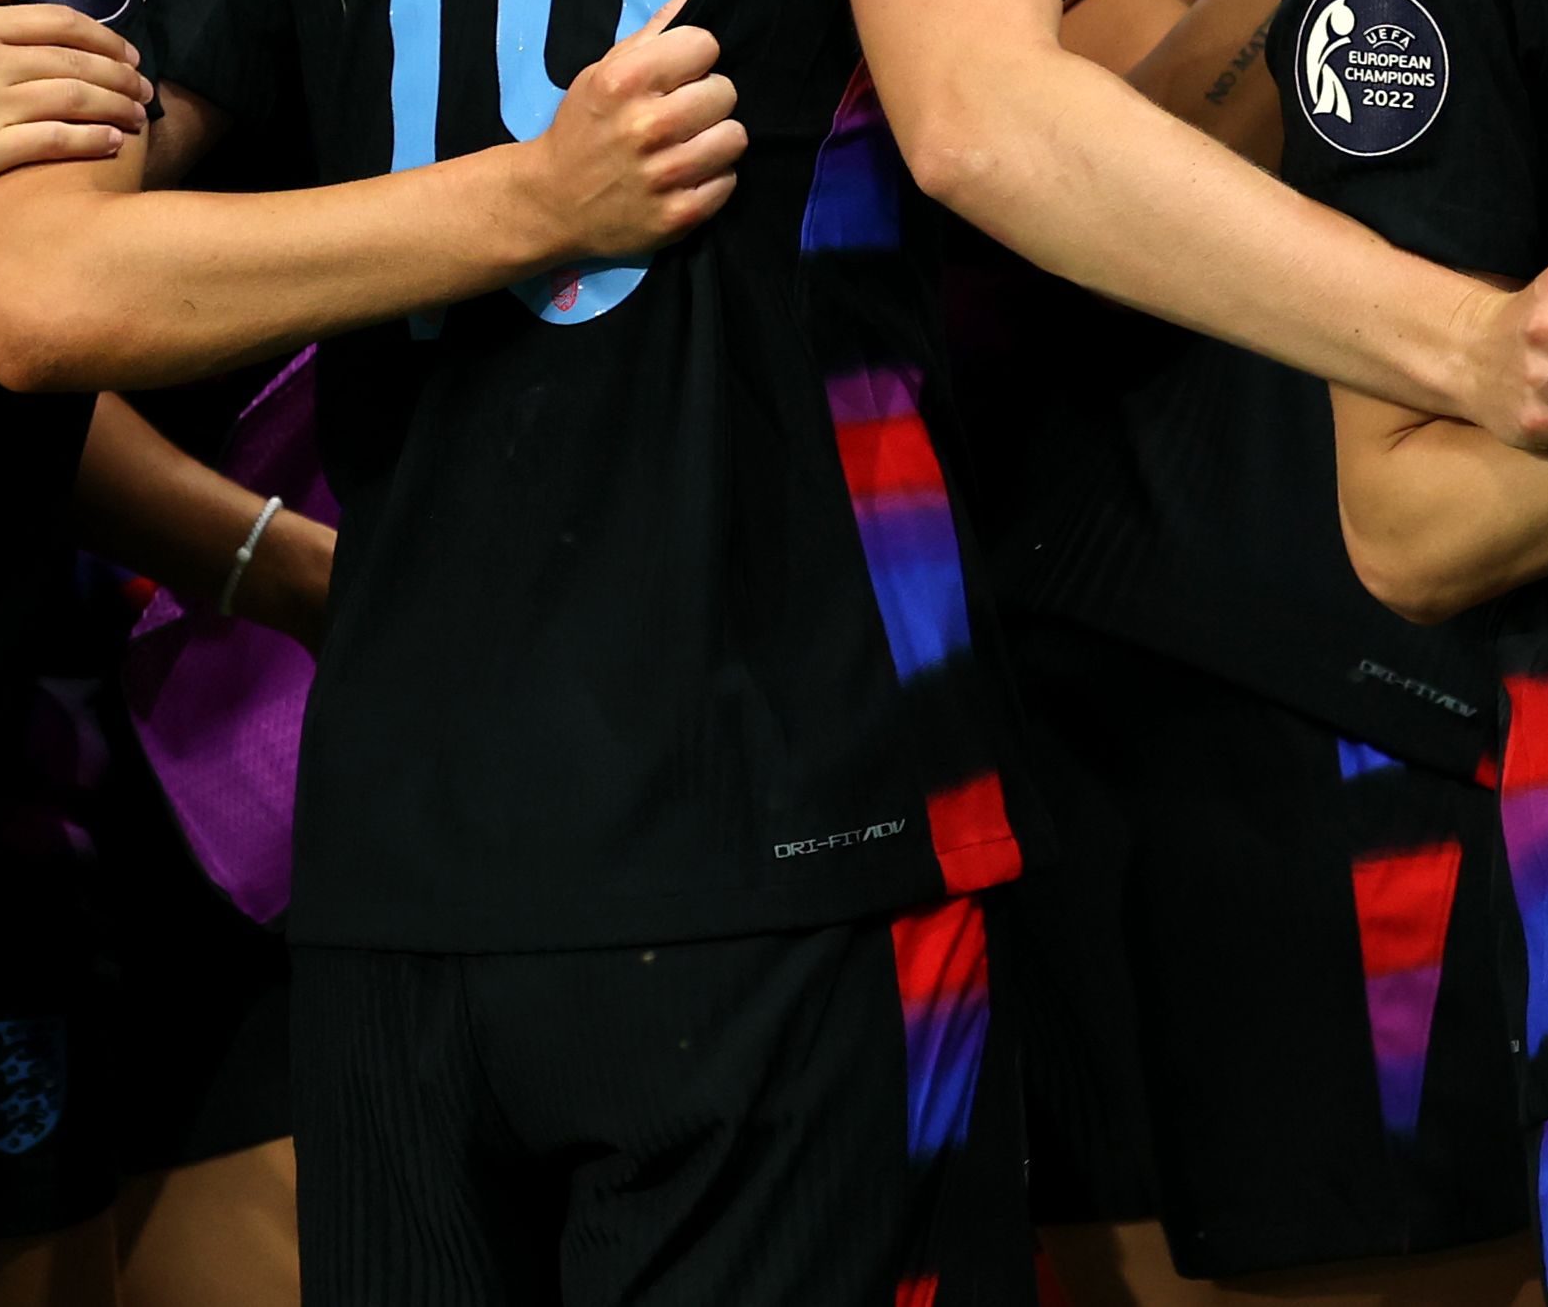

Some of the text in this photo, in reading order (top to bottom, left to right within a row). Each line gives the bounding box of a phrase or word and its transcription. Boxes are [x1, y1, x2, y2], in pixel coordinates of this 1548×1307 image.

[1365, 27, 1411, 49] UEFA
[1347, 49, 1432, 70] EUROPEAN
[1344, 66, 1437, 88] CHAMPIONS
[1361, 87, 1415, 109] 2022
